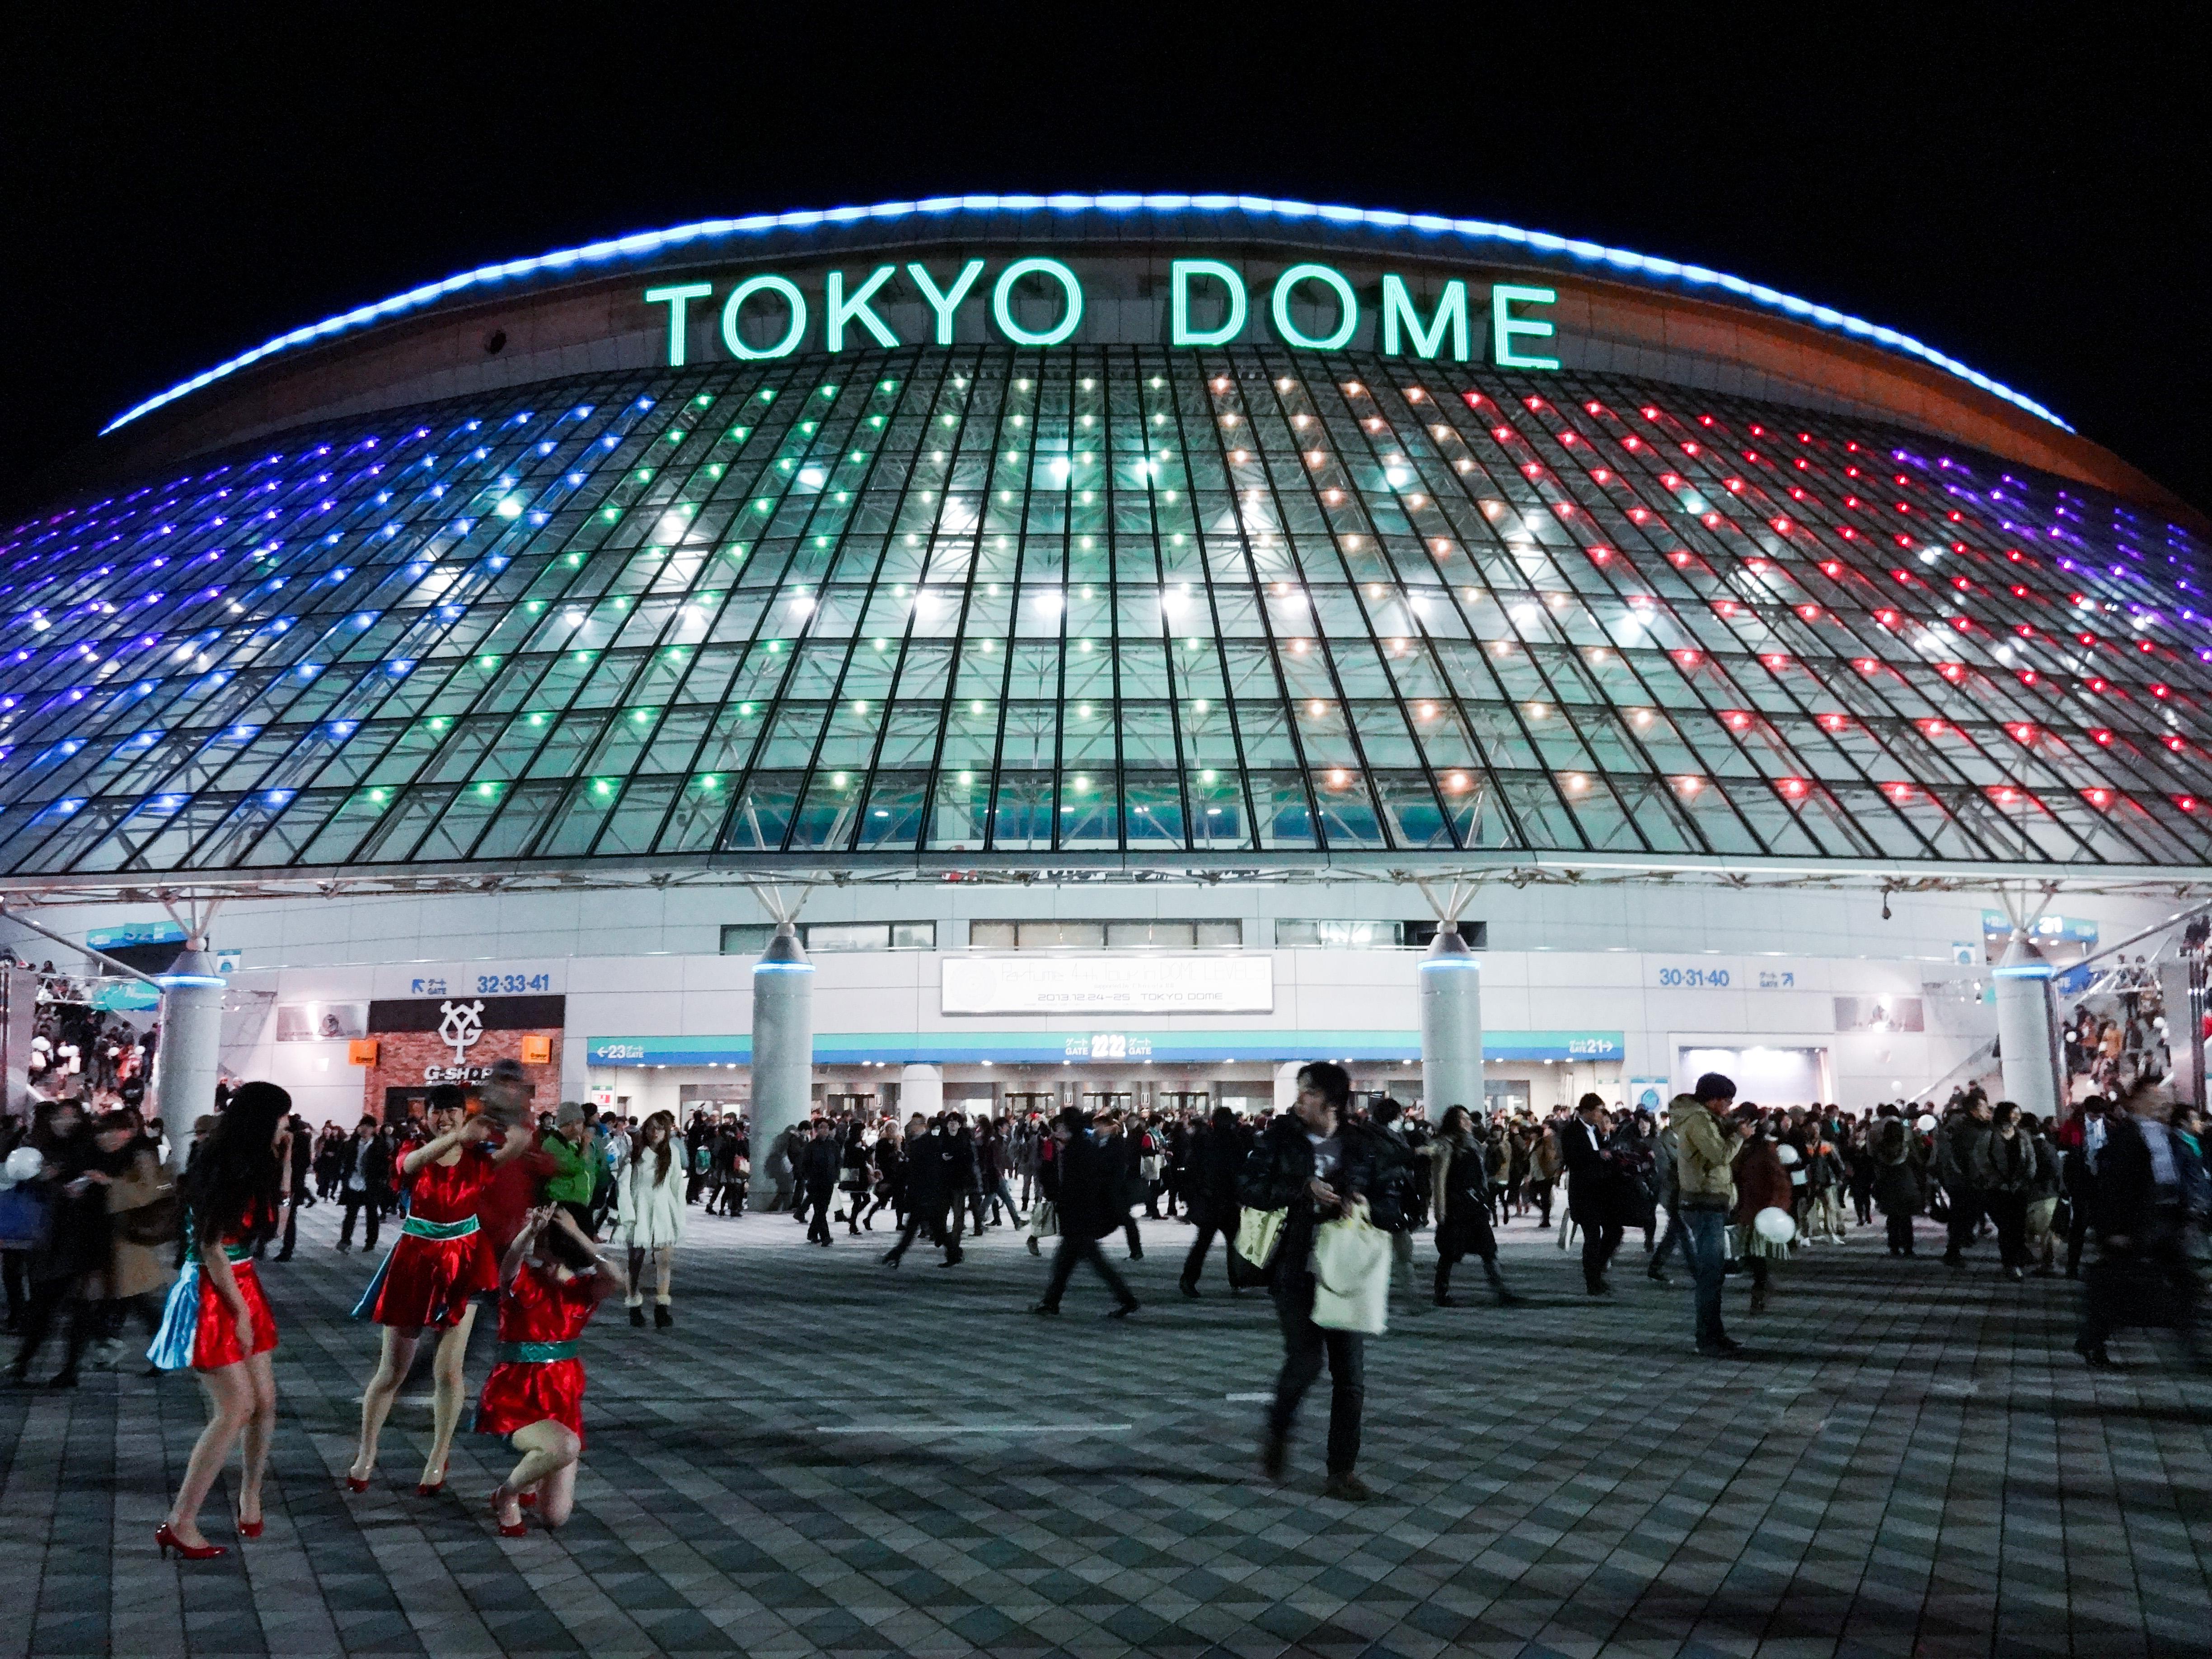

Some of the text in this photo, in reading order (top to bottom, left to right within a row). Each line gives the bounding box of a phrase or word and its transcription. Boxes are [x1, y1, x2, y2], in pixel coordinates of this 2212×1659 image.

[646, 258, 1561, 371] TOKYO DOME
[2039, 917, 2063, 933] 31
[1065, 1037, 1088, 1046] ゲート
[1129, 1037, 1152, 1046] ゲート
[1587, 1040, 1603, 1054] 21
[608, 1045, 626, 1059] 23
[1065, 1047, 1088, 1055] GATE
[1129, 1047, 1152, 1055] GATE
